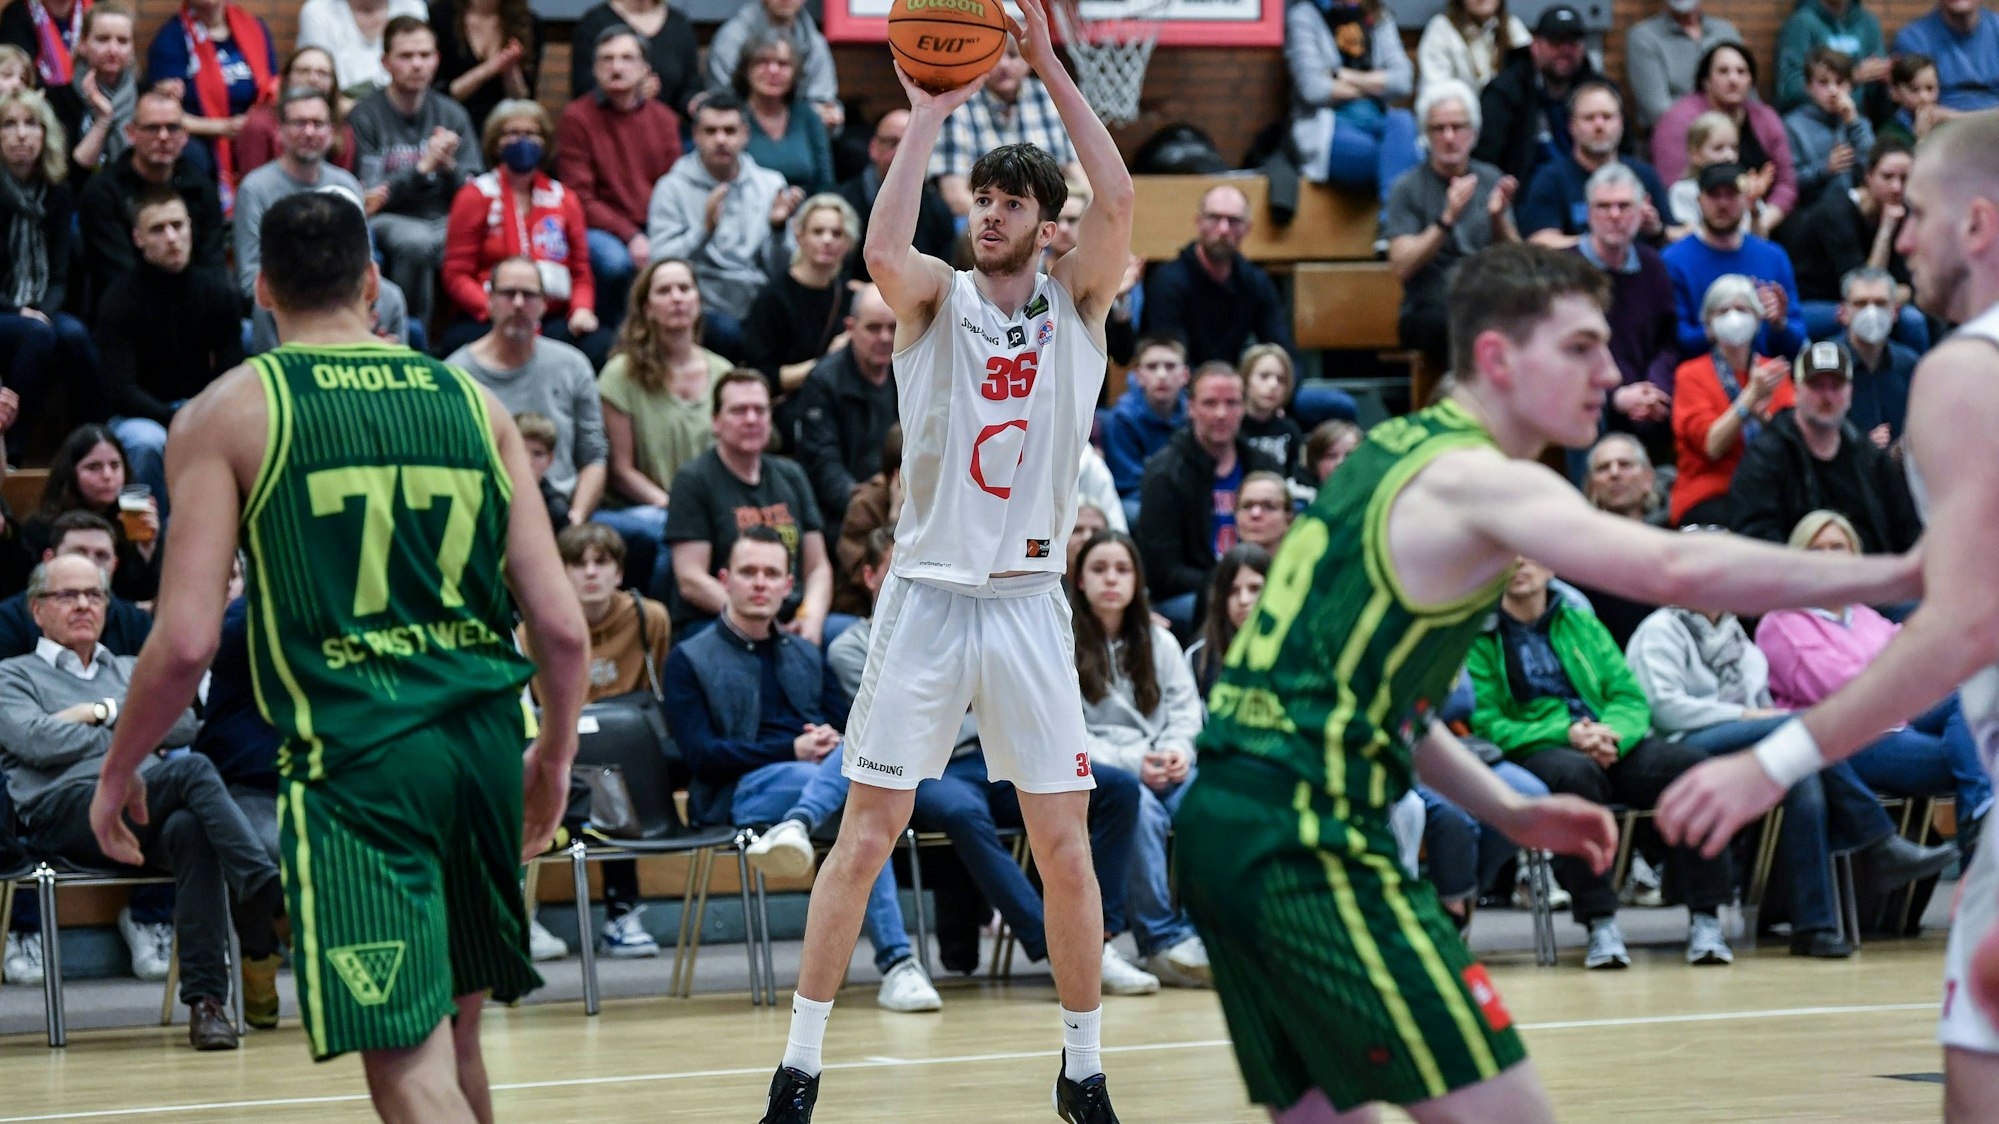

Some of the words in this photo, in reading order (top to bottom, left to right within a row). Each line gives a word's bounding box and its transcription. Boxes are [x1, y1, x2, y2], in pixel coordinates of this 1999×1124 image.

[312, 363, 440, 392] OKOLIE
[981, 351, 1038, 401] 35
[306, 464, 485, 618] 77
[322, 635, 366, 670] SC
[857, 756, 904, 776] SPALDING
[1075, 752, 1092, 777] 3
